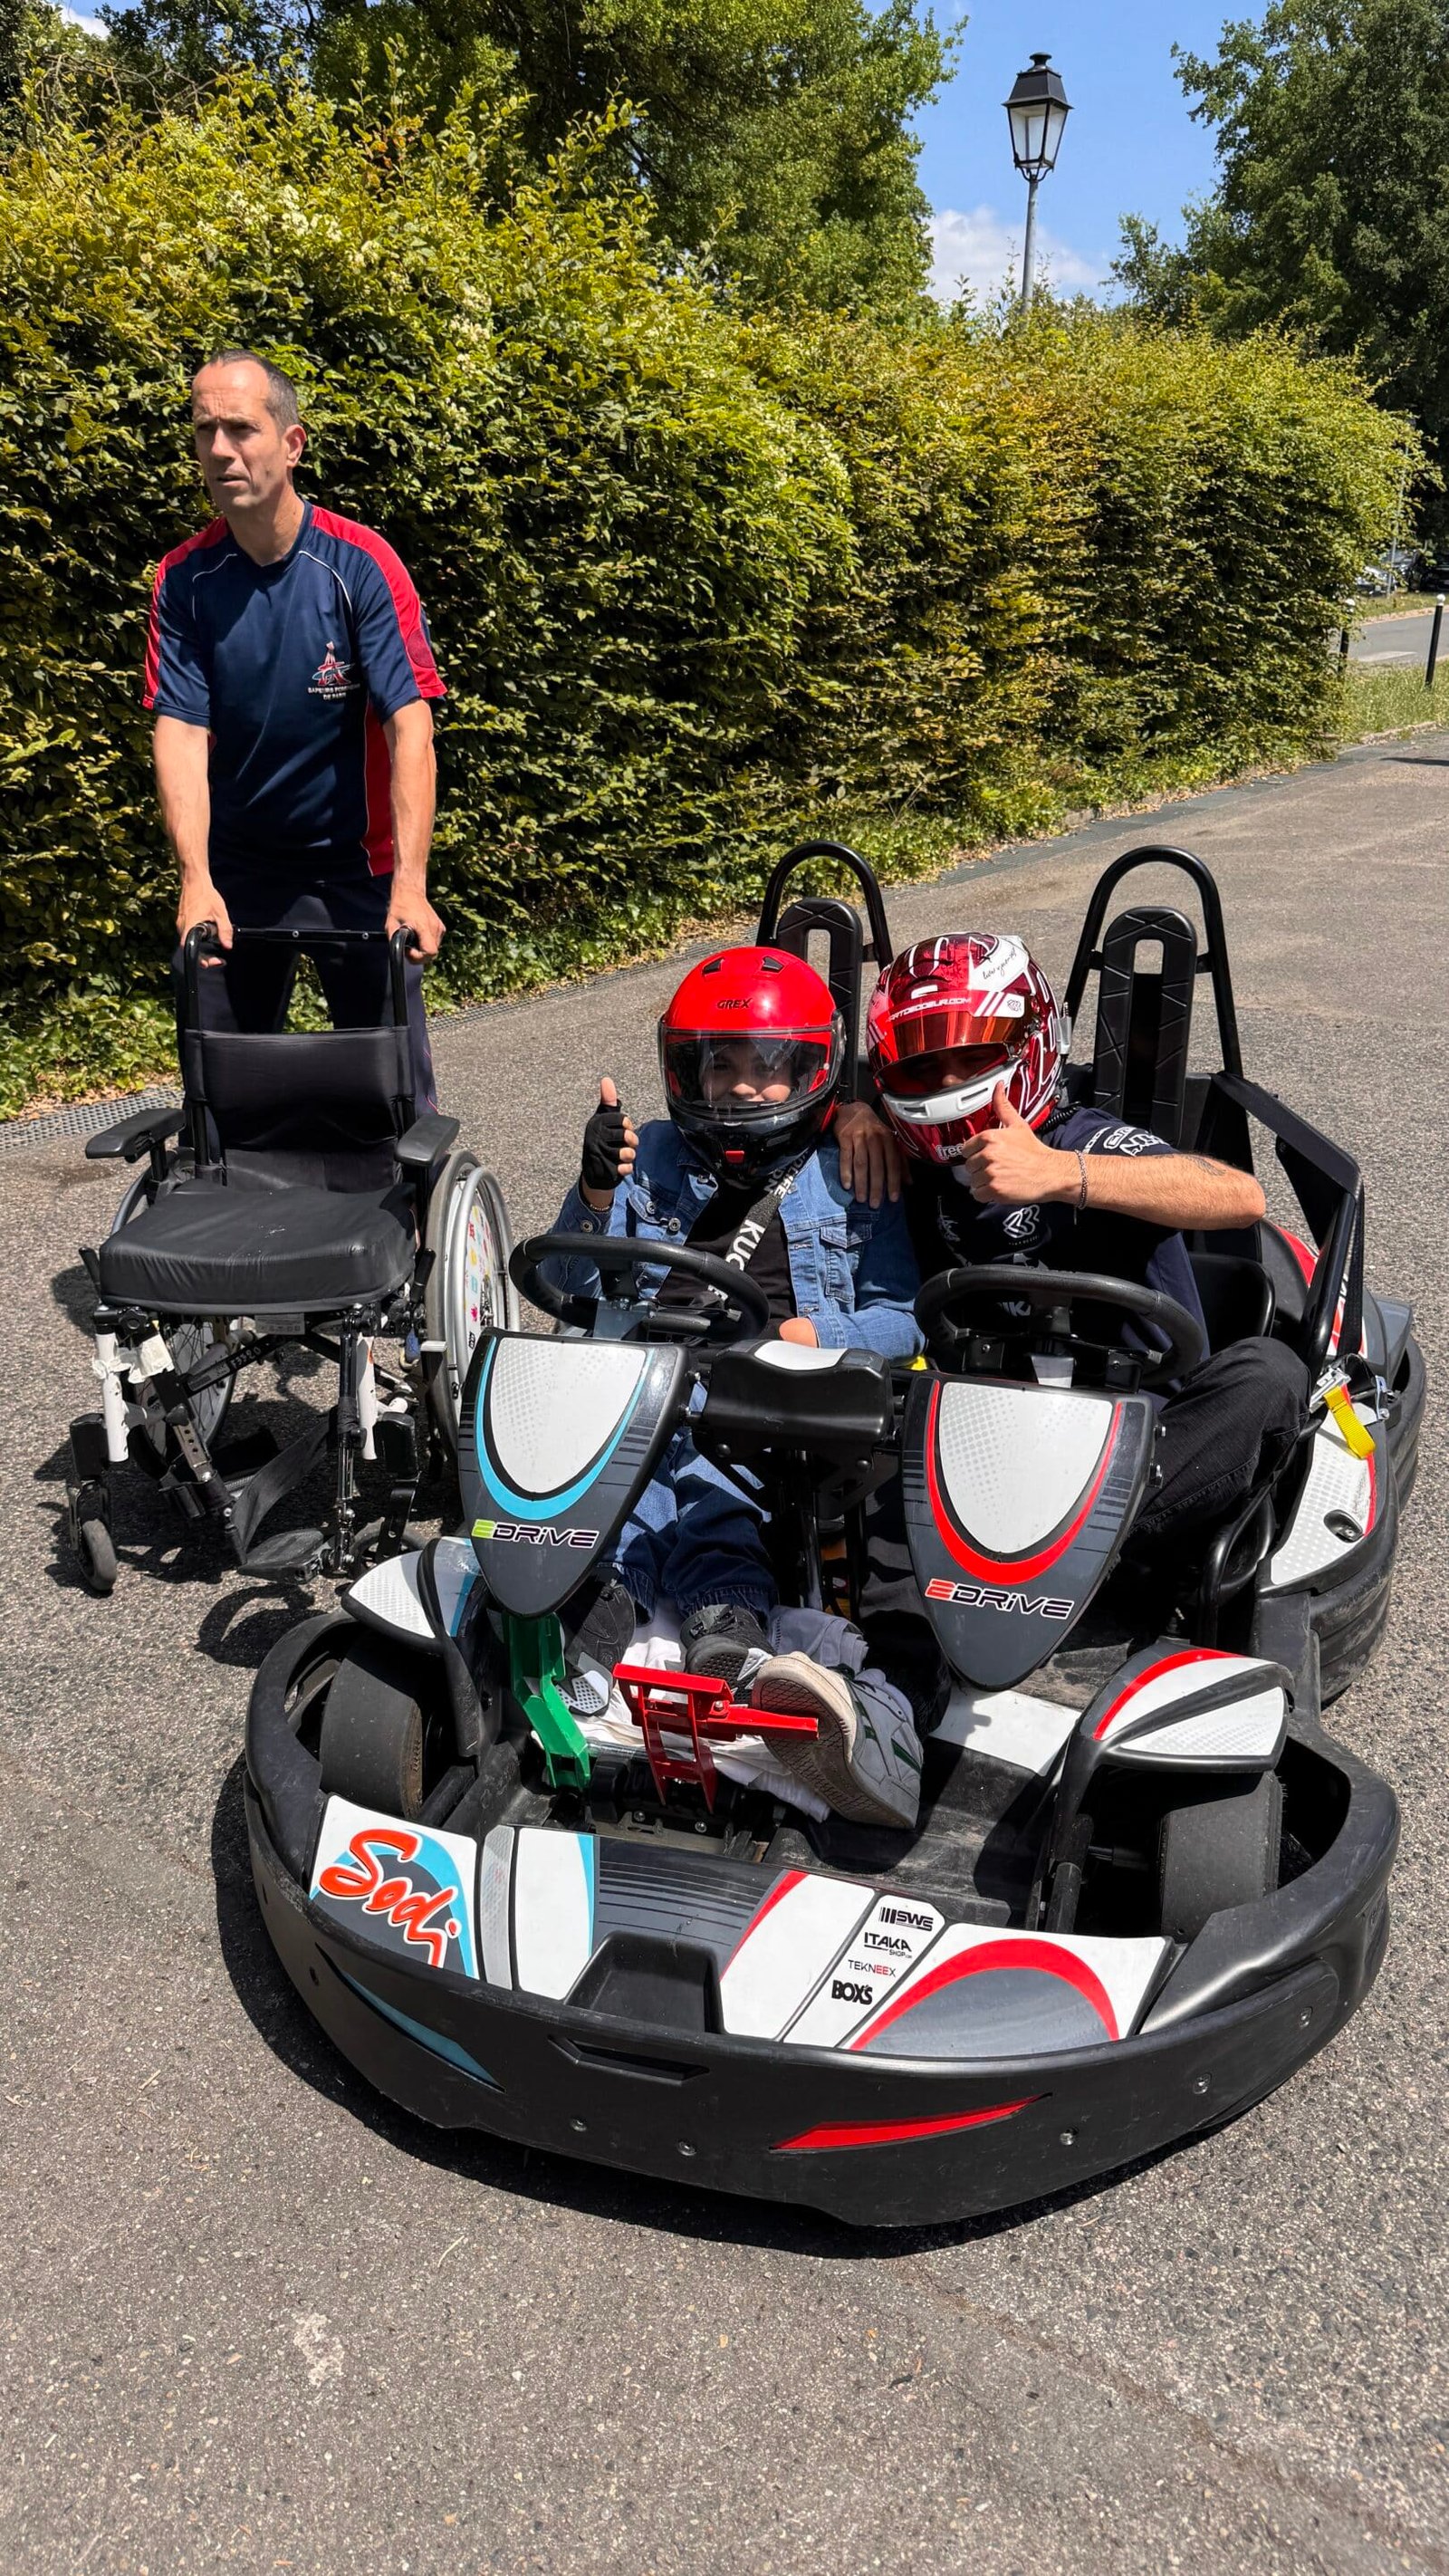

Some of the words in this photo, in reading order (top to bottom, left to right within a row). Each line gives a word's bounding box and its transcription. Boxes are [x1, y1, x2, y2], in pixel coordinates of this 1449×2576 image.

[716, 997, 753, 1010] GREX
[318, 1829, 461, 1968] Sodi
[864, 1932, 912, 1953] ITAKA
[848, 1959, 897, 1977] TEKNEEX
